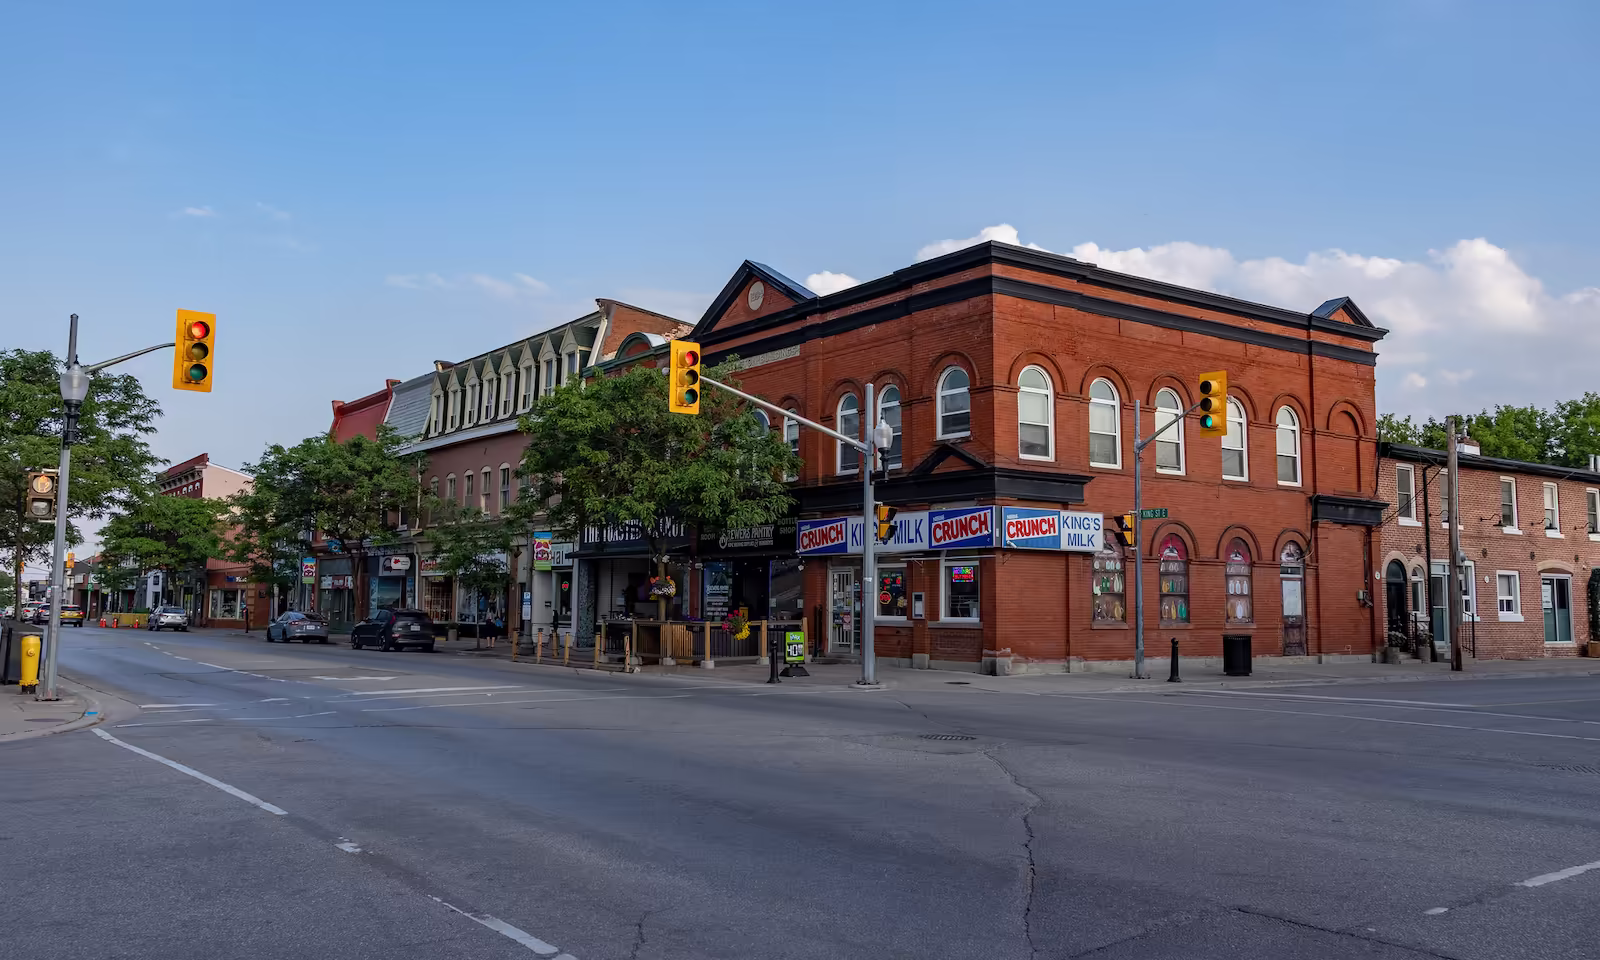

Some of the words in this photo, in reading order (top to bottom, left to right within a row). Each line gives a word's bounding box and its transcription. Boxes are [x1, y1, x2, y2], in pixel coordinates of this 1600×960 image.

[1142, 510, 1154, 518] KING
[779, 526, 796, 535] SHOP
[894, 518, 923, 544] MILK
[932, 512, 989, 543] CRUNCH
[1007, 517, 1056, 539] CRUNCH
[1062, 515, 1101, 531] KING'S
[584, 524, 600, 543] THE
[751, 525, 774, 539] PANTRY
[800, 524, 844, 549] CRUNCH
[1067, 533, 1095, 547] MILK
